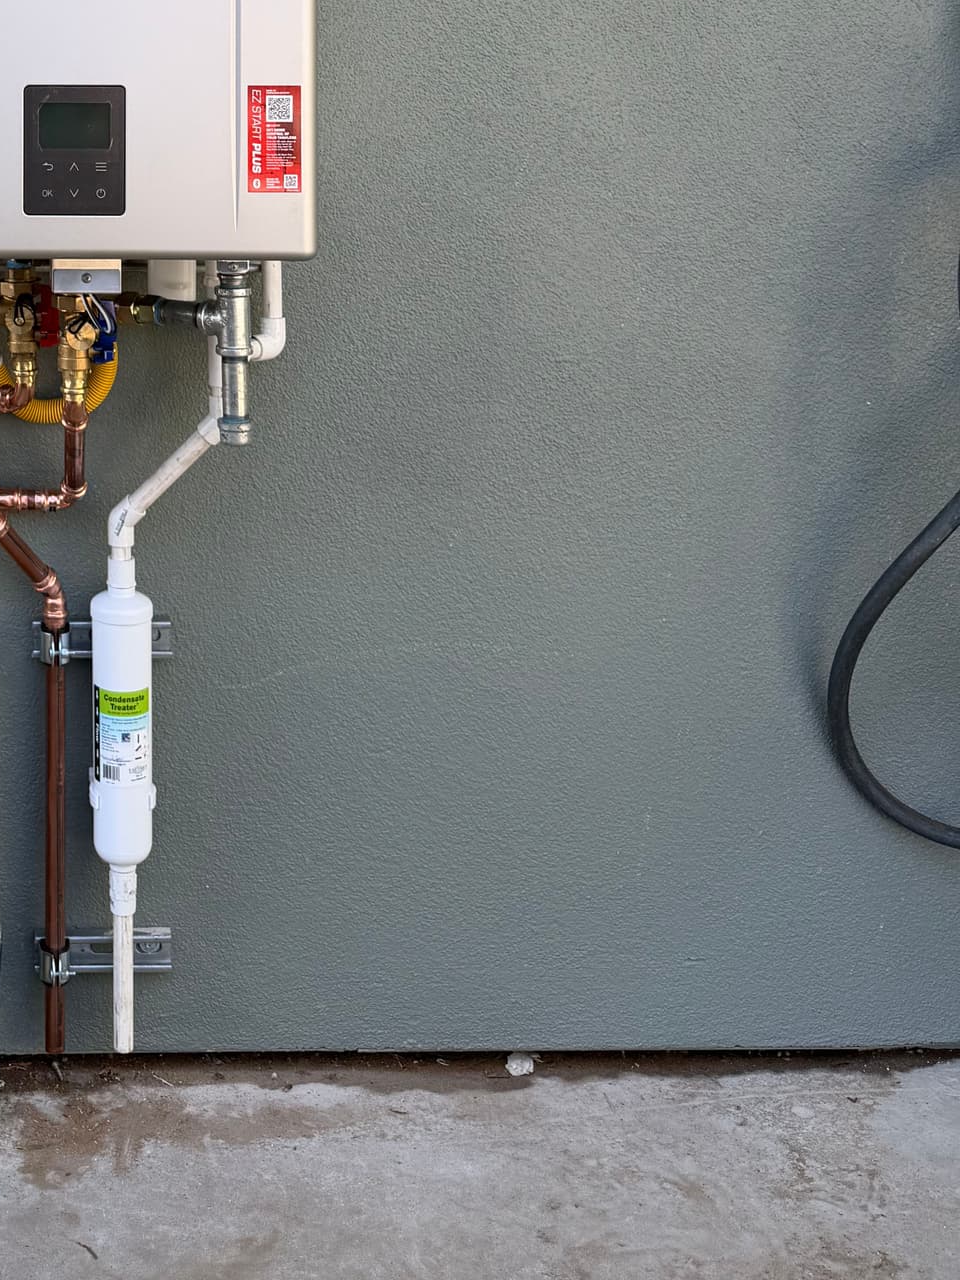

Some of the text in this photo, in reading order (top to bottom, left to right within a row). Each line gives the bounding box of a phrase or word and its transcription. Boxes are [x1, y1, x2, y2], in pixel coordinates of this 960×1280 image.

[251, 89, 262, 174] EZ START PLUS
[41, 189, 54, 198] OK
[103, 694, 145, 704] Condensate
